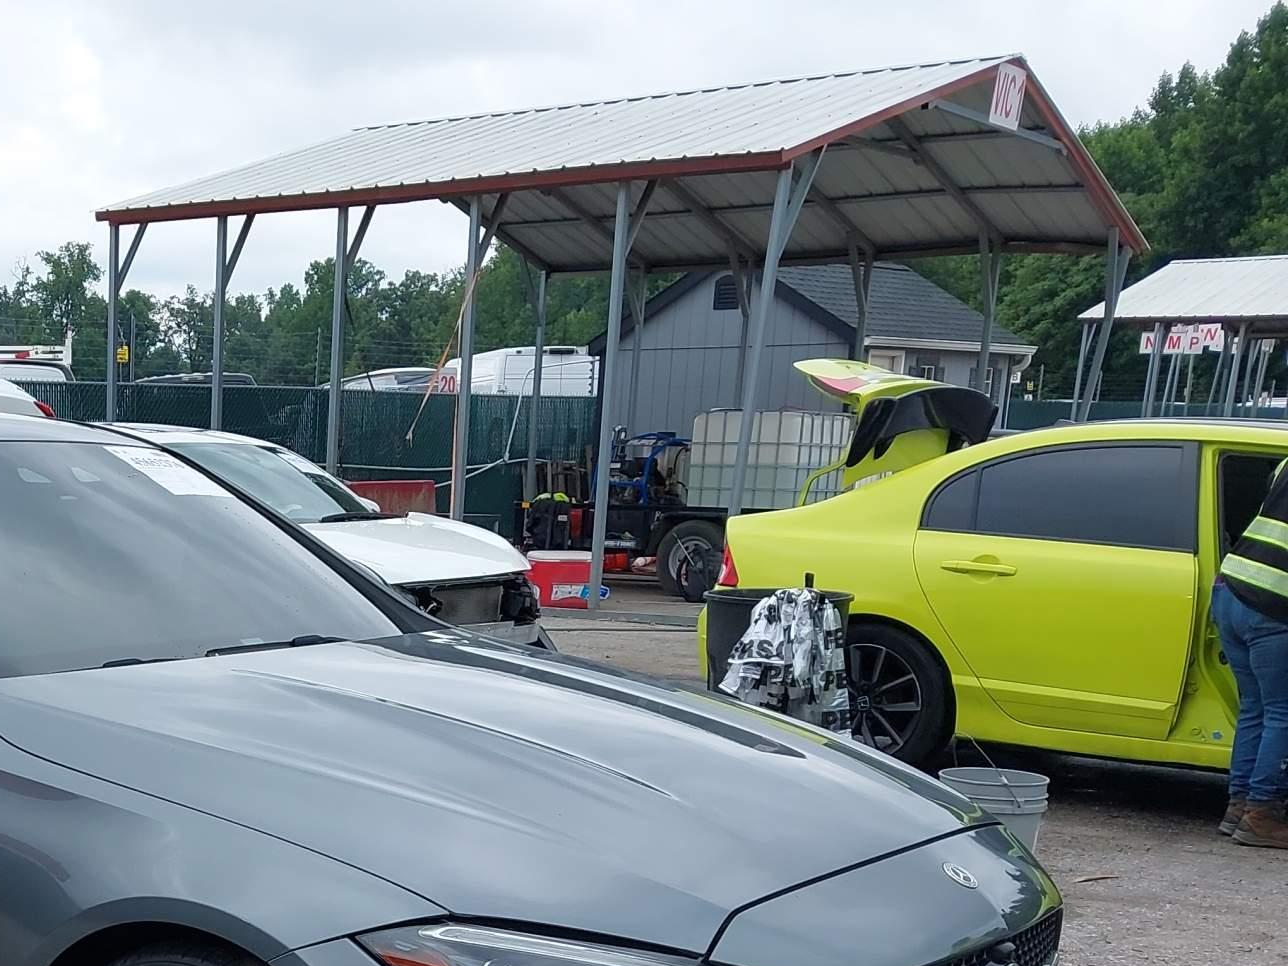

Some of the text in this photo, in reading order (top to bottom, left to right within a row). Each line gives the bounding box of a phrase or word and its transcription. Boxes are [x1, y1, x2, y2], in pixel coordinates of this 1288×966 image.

[994, 69, 1017, 119] VIC
[1167, 335, 1182, 349] M
[1189, 336, 1200, 350] P
[440, 375, 457, 393] 20
